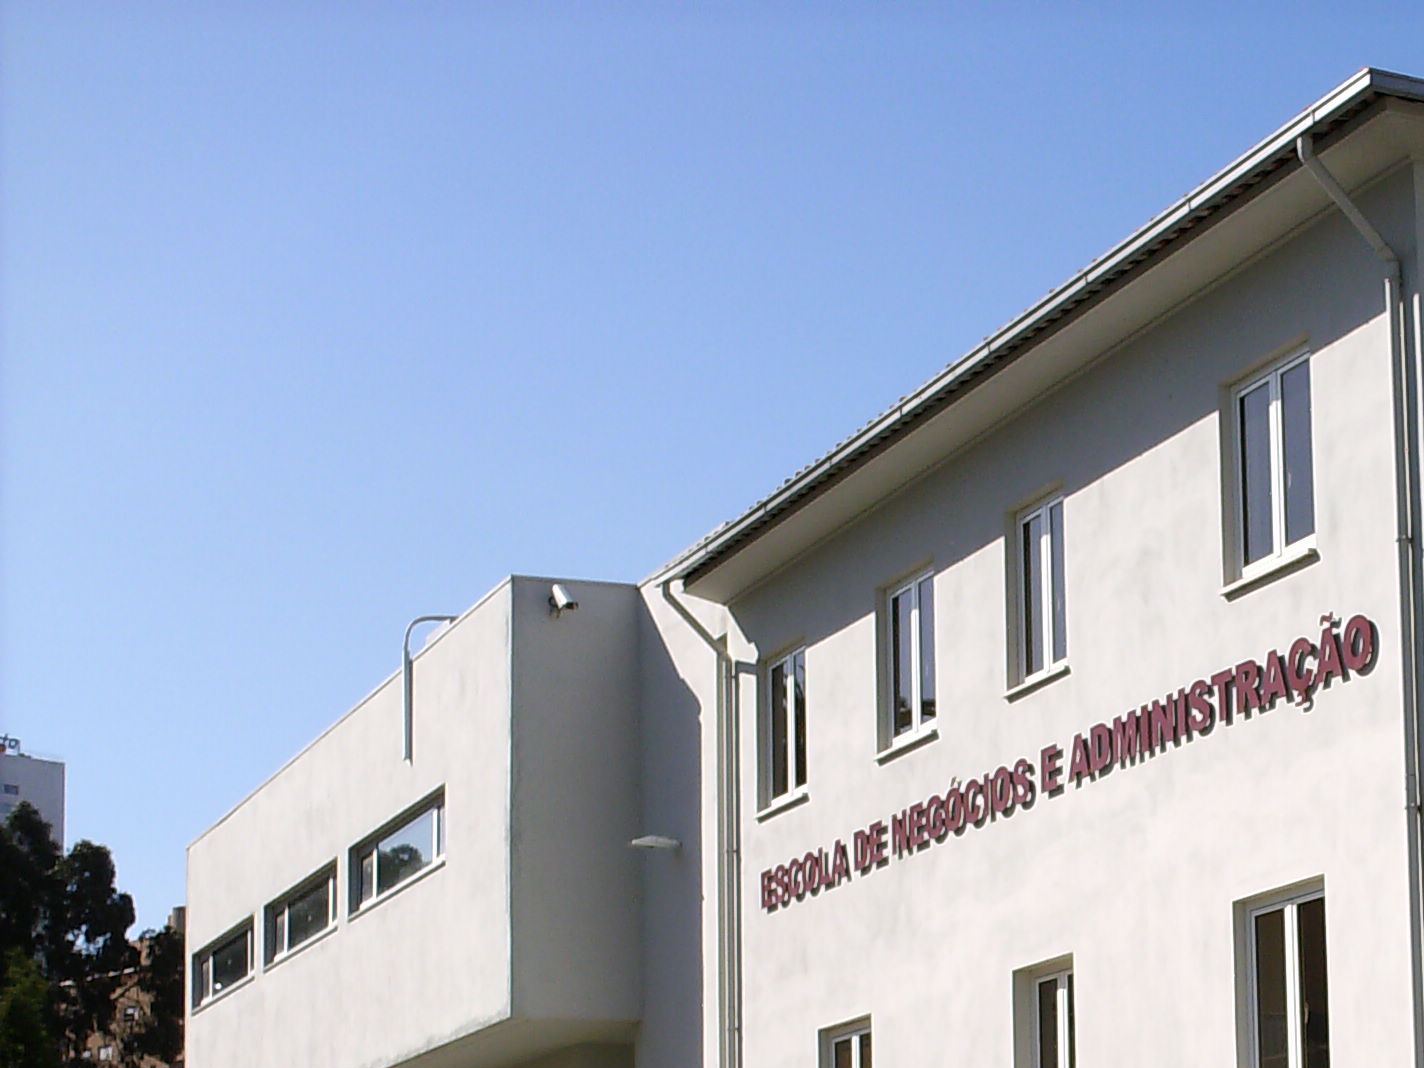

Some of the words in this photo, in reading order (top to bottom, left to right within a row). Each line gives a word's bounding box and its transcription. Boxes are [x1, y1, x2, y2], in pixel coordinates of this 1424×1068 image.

[761, 840, 847, 909] ESCOLA
[854, 822, 888, 870] DE
[892, 758, 1031, 853] NEGÓCIOS
[1042, 745, 1062, 793] E
[1069, 613, 1373, 782] ADMINISTRAÇÃO
